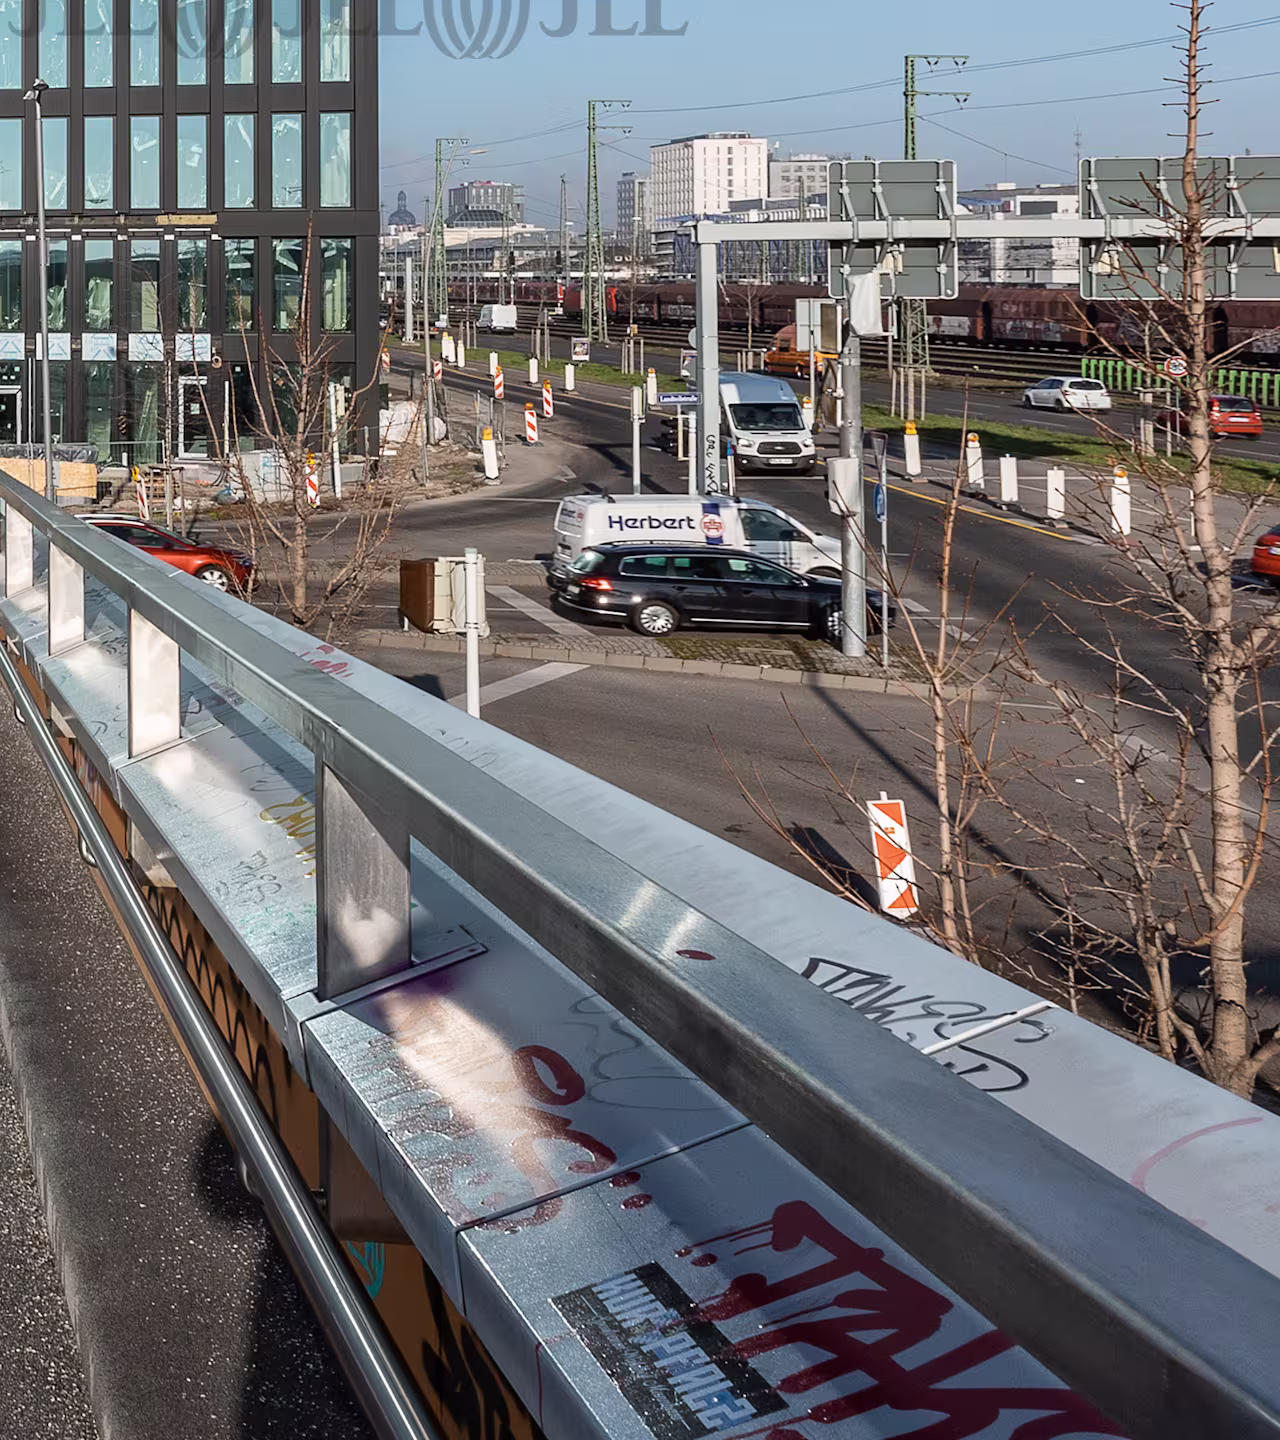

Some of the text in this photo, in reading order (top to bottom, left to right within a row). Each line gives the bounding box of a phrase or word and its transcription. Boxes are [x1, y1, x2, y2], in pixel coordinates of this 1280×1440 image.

[608, 515, 696, 532] Herbert
[590, 1271, 669, 1329] KUR
[638, 1329, 757, 1431] PFALZ
